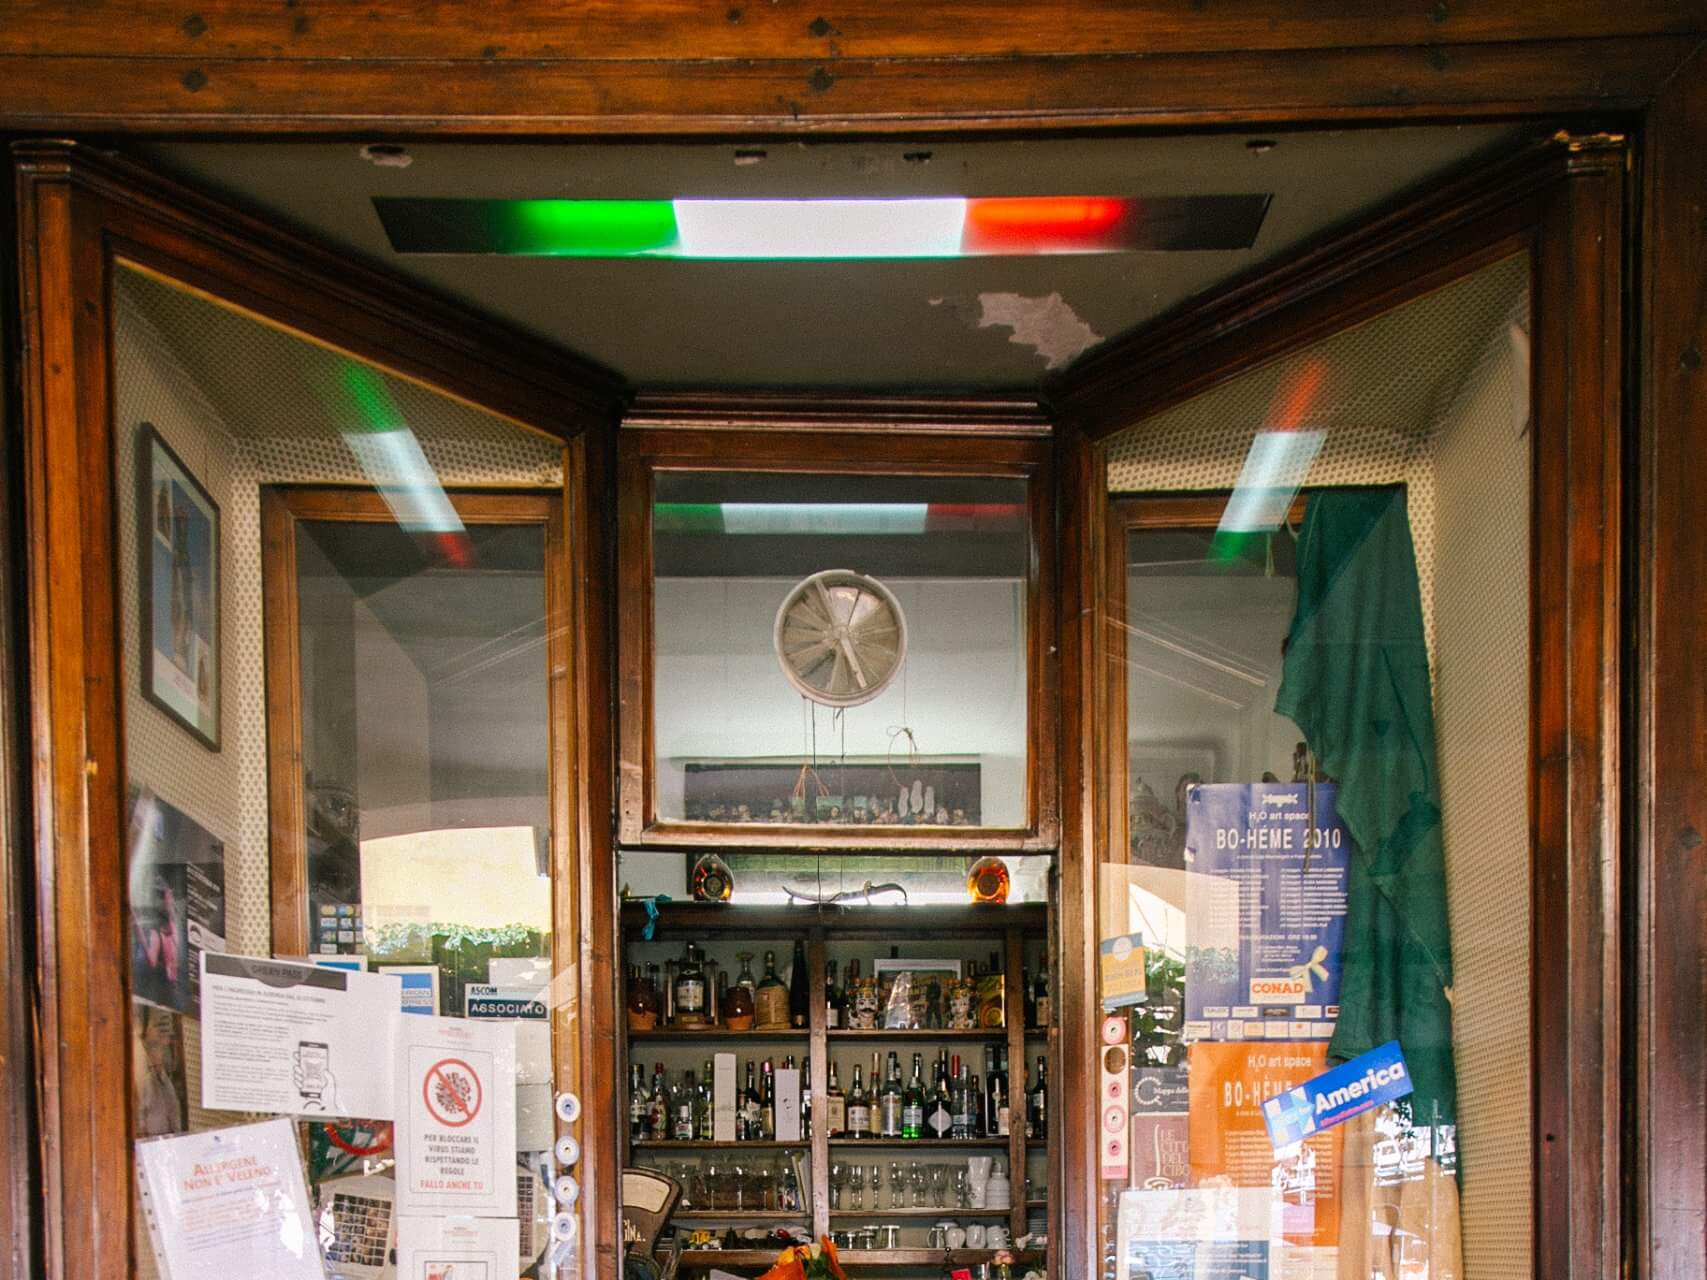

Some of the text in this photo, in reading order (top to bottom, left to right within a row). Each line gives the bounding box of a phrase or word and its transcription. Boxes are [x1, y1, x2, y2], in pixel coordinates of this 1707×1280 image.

[1269, 811, 1283, 821] art
[1303, 828, 1341, 849] 2010
[470, 986, 498, 995] ASCOM
[1252, 983, 1304, 994] CONAD
[471, 1003, 545, 1015] ASSOCIATO
[1315, 1062, 1406, 1115] America
